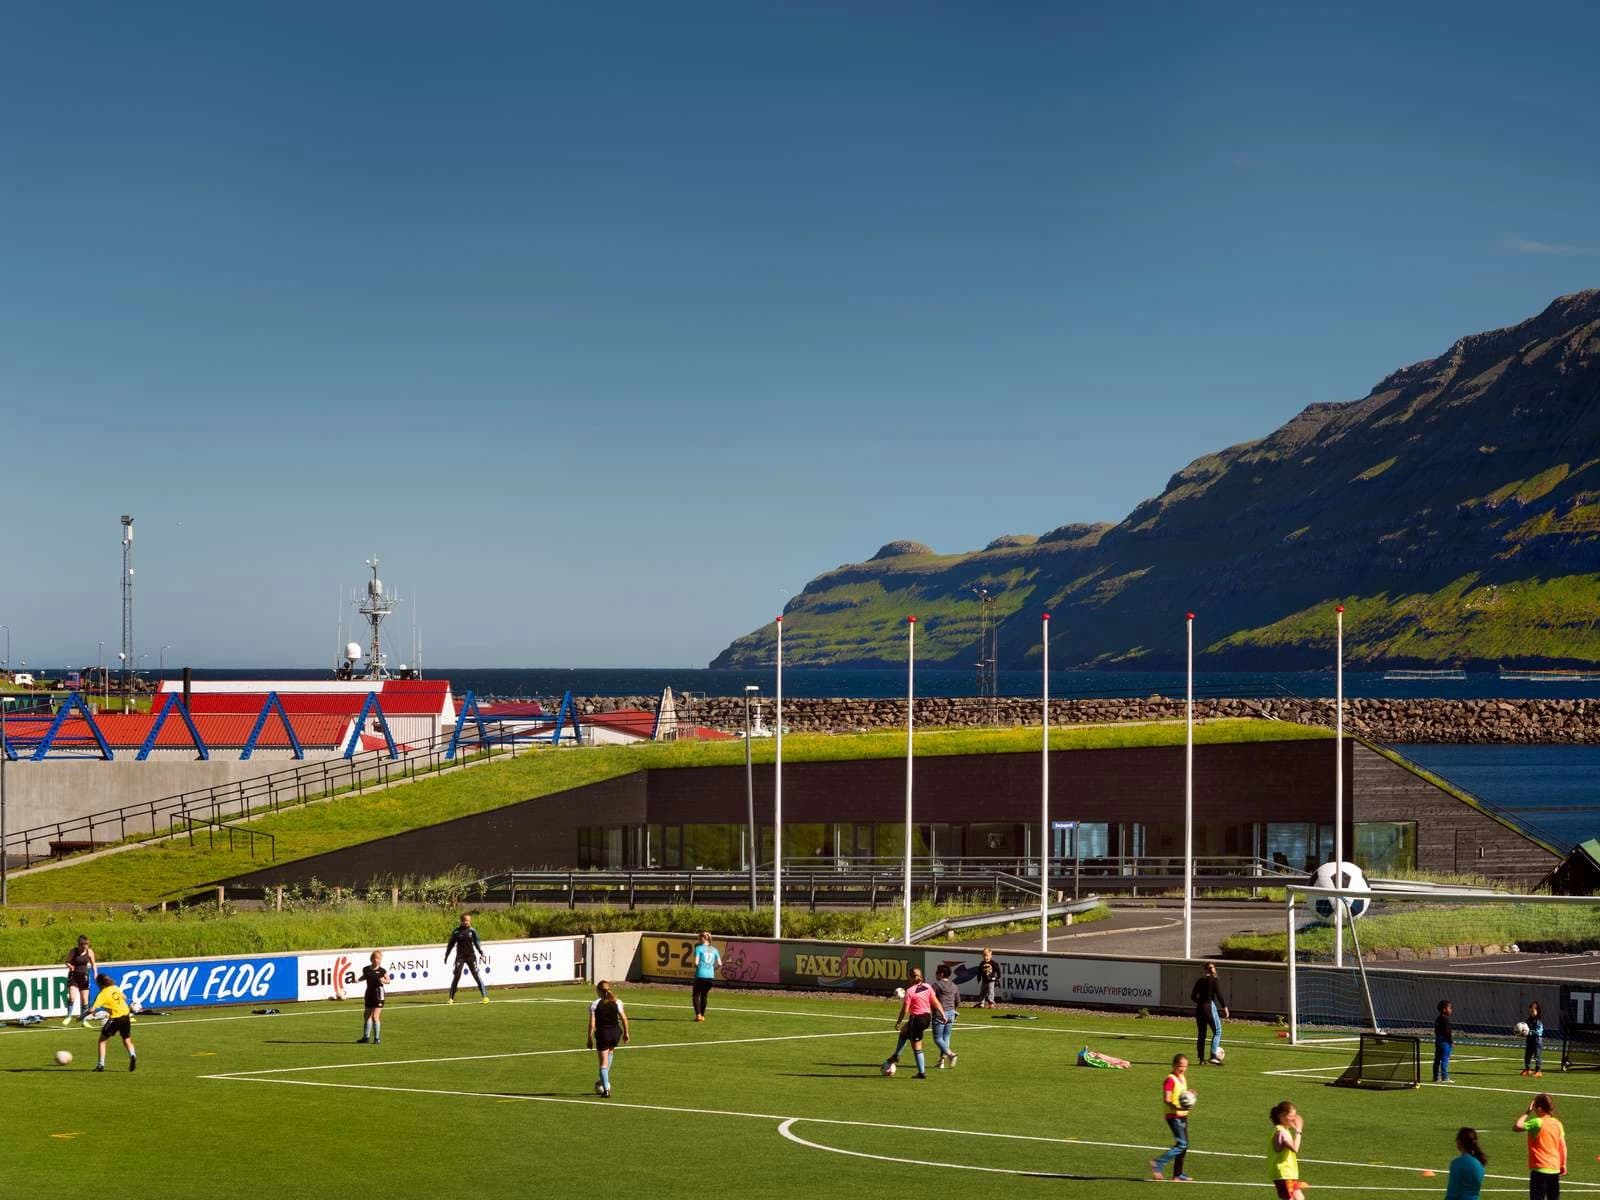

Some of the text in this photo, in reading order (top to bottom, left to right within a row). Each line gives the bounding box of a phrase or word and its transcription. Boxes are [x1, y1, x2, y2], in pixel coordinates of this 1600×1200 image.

[389, 959, 429, 971] ANSNI
[515, 952, 552, 963] ANSNI
[795, 954, 909, 981] FAXE KONDI
[1000, 962, 1049, 977] TLANTIC
[203, 962, 275, 1000] FLOG
[994, 978, 1049, 992] AIRWAYS
[0, 976, 69, 1013] OHR
